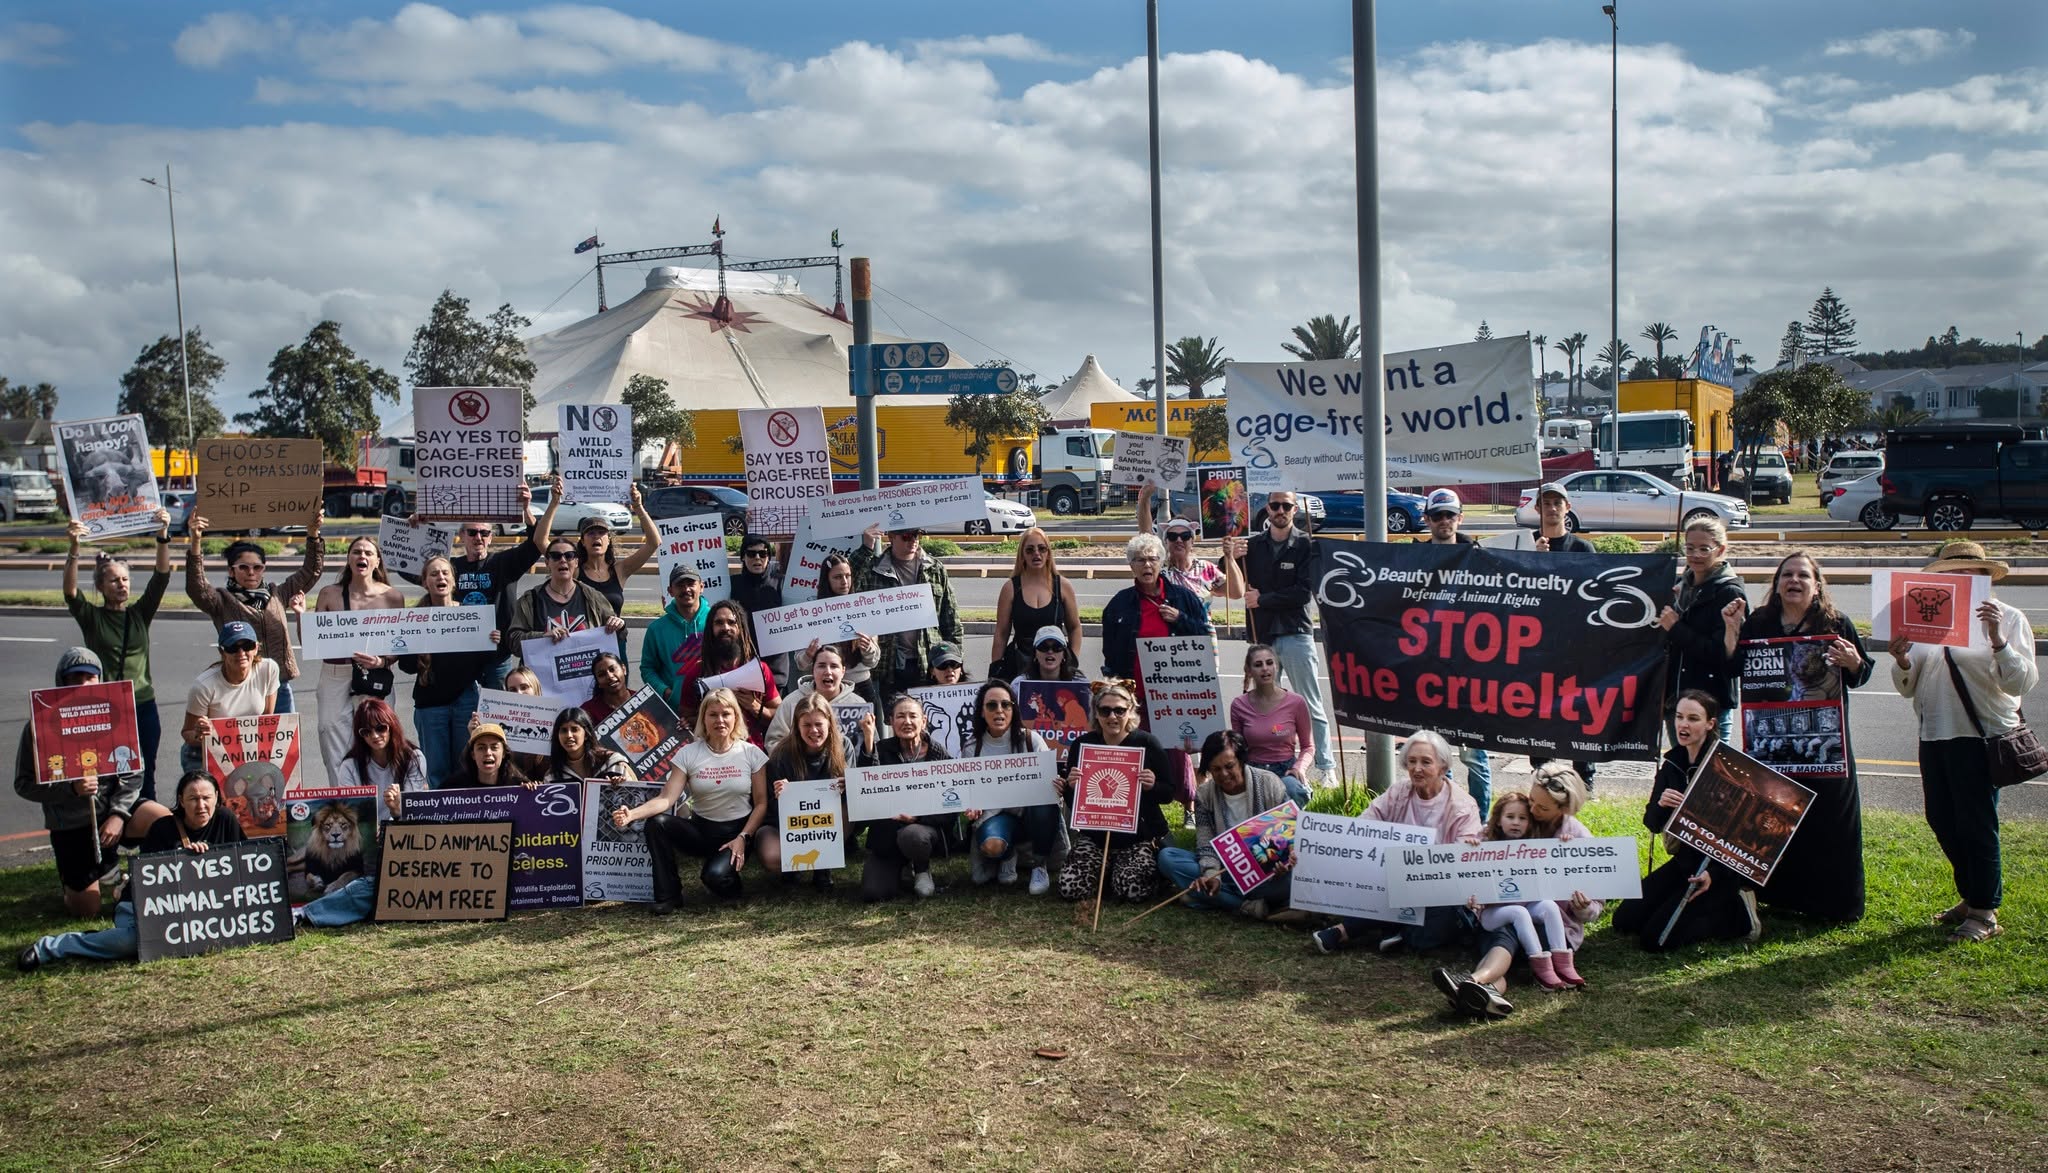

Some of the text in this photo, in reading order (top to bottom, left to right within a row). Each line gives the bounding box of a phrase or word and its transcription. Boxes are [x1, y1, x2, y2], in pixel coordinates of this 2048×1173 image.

[948, 371, 993, 382] Woodbridge
[1276, 358, 1456, 396] We wnt a
[1401, 391, 1523, 433] world.
[61, 420, 138, 440] Do I LOOK
[416, 430, 521, 444] SAY YES TO
[1120, 431, 1143, 441] Shame
[74, 434, 129, 453] happy?
[579, 437, 612, 447] WILD
[1129, 441, 1144, 449] you!
[207, 444, 290, 461] CHOOSE
[416, 447, 522, 461] CAGE-FREE
[568, 448, 623, 458] ANIMALS
[746, 450, 827, 466] SAY YES TO
[1284, 455, 1312, 466] Beauty
[1313, 453, 1343, 464] without
[1409, 453, 1440, 464] LIVING
[1442, 448, 1488, 462] WITHOUT
[1490, 441, 1538, 457] CRUELTY
[589, 459, 603, 469] IN
[1118, 456, 1152, 465] SANParks
[420, 465, 520, 478] CIRCUSES!
[564, 470, 627, 480] CIRCUSES!
[748, 467, 830, 483] CAGE-FREE
[1208, 469, 1243, 481] PRIDE
[205, 482, 250, 497] SKIP
[751, 485, 829, 500] CIRCUSES!
[232, 496, 319, 514] THE SHOW!
[659, 521, 718, 536] The circus
[660, 536, 722, 556] is NOT FUN
[696, 559, 716, 570] the
[1378, 567, 1573, 595] Beauty Without Cruelty
[1402, 587, 1541, 609] Defending Animal Rights
[316, 610, 481, 628] We love animal-free circuses.
[1399, 607, 1543, 665] STOP
[1144, 640, 1205, 655] You get to
[1747, 647, 1785, 658] WASN'T
[559, 651, 598, 664] ANIMALS
[1154, 657, 1202, 672] go home
[1744, 656, 1785, 670] BORN
[1145, 672, 1216, 684] afterwards-
[623, 685, 655, 712] FREE
[1148, 689, 1217, 701] The animals
[1330, 651, 1638, 736] the cruelty!
[60, 708, 110, 719] WILD ANIMALS
[490, 713, 526, 724] ANIMAL-FREE
[1154, 705, 1217, 720] get a cage!
[62, 723, 112, 736] IN CIRCUSES
[225, 717, 279, 729] CIRCUSES:
[211, 730, 294, 747] NO FUN FOR
[1433, 725, 1485, 742] Factory Farming
[656, 736, 680, 756] FOR
[1496, 735, 1556, 749] Cosmetic Testing
[1571, 741, 1649, 752] Wildlife Exploitation
[220, 748, 284, 764] ANIMALS
[636, 752, 658, 774] NOT
[1795, 764, 1842, 773] MADNESS
[289, 787, 376, 799] BAN CANNED HUNTING
[405, 793, 519, 808] Beauty Without Cruelty
[799, 799, 820, 811] End
[790, 814, 832, 828] Big Cat
[786, 830, 837, 844] Captivity
[1301, 815, 1428, 845] Circus Animals are
[389, 834, 509, 854] WILD ANIMALS
[514, 831, 579, 848] olidarity
[1679, 816, 1770, 872] NO TO ANIMALS
[591, 841, 649, 854] FUN FOR YO
[1300, 838, 1363, 860] Prisoners
[1367, 847, 1377, 862] 4
[1403, 850, 1425, 866] We
[1428, 849, 1456, 864] love
[1461, 843, 1548, 864] animal-free
[1550, 844, 1618, 859] circuses.
[1679, 830, 1755, 877] IN CIRCUSES!
[585, 855, 623, 867] PRISON
[624, 857, 646, 868] FOR
[1218, 832, 1260, 888] PRIDE
[141, 853, 272, 886] SAY YES TO
[388, 860, 493, 880] DESERVE TO
[515, 883, 576, 893] Wildlife Exploitation
[143, 880, 282, 917] ANIMAL-FREE
[388, 888, 497, 911] ROAM FREE
[165, 910, 275, 945] CIRCUSES
